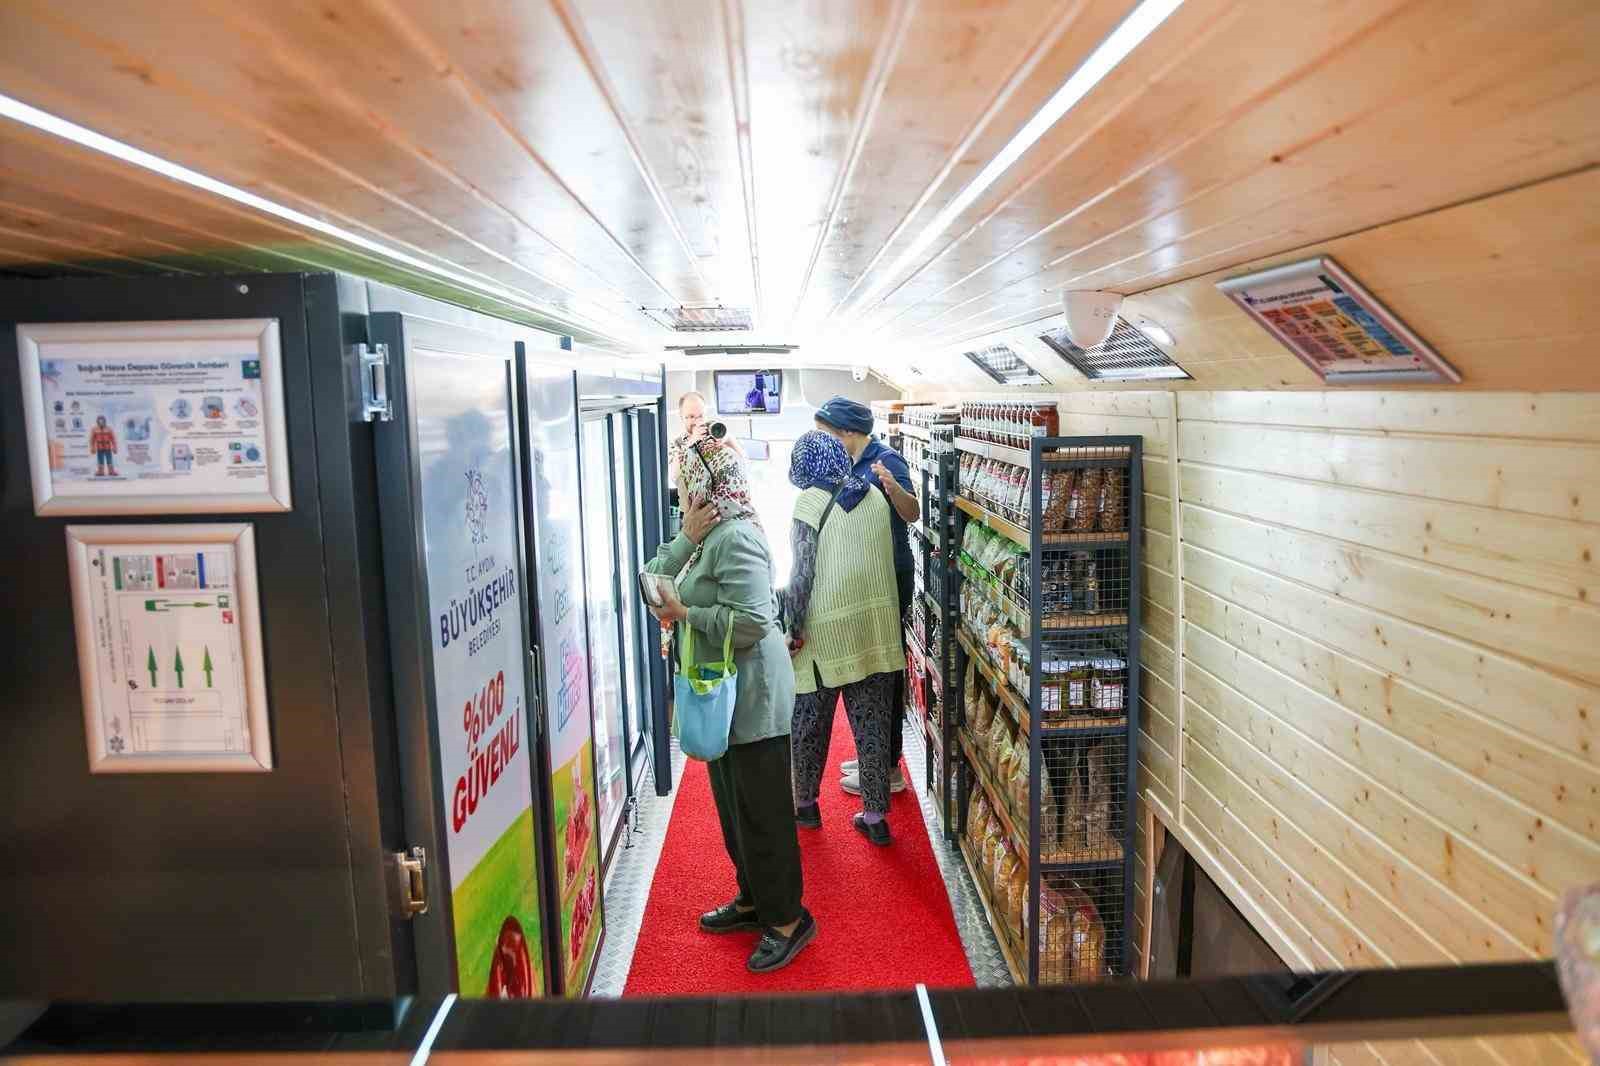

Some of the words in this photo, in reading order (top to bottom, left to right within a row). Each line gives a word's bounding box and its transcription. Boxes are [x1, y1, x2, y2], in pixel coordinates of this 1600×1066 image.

[440, 565, 515, 648] BÜYÜKŞEHİR
[463, 670, 504, 753] %100
[453, 696, 520, 833] GÜVENLİ
